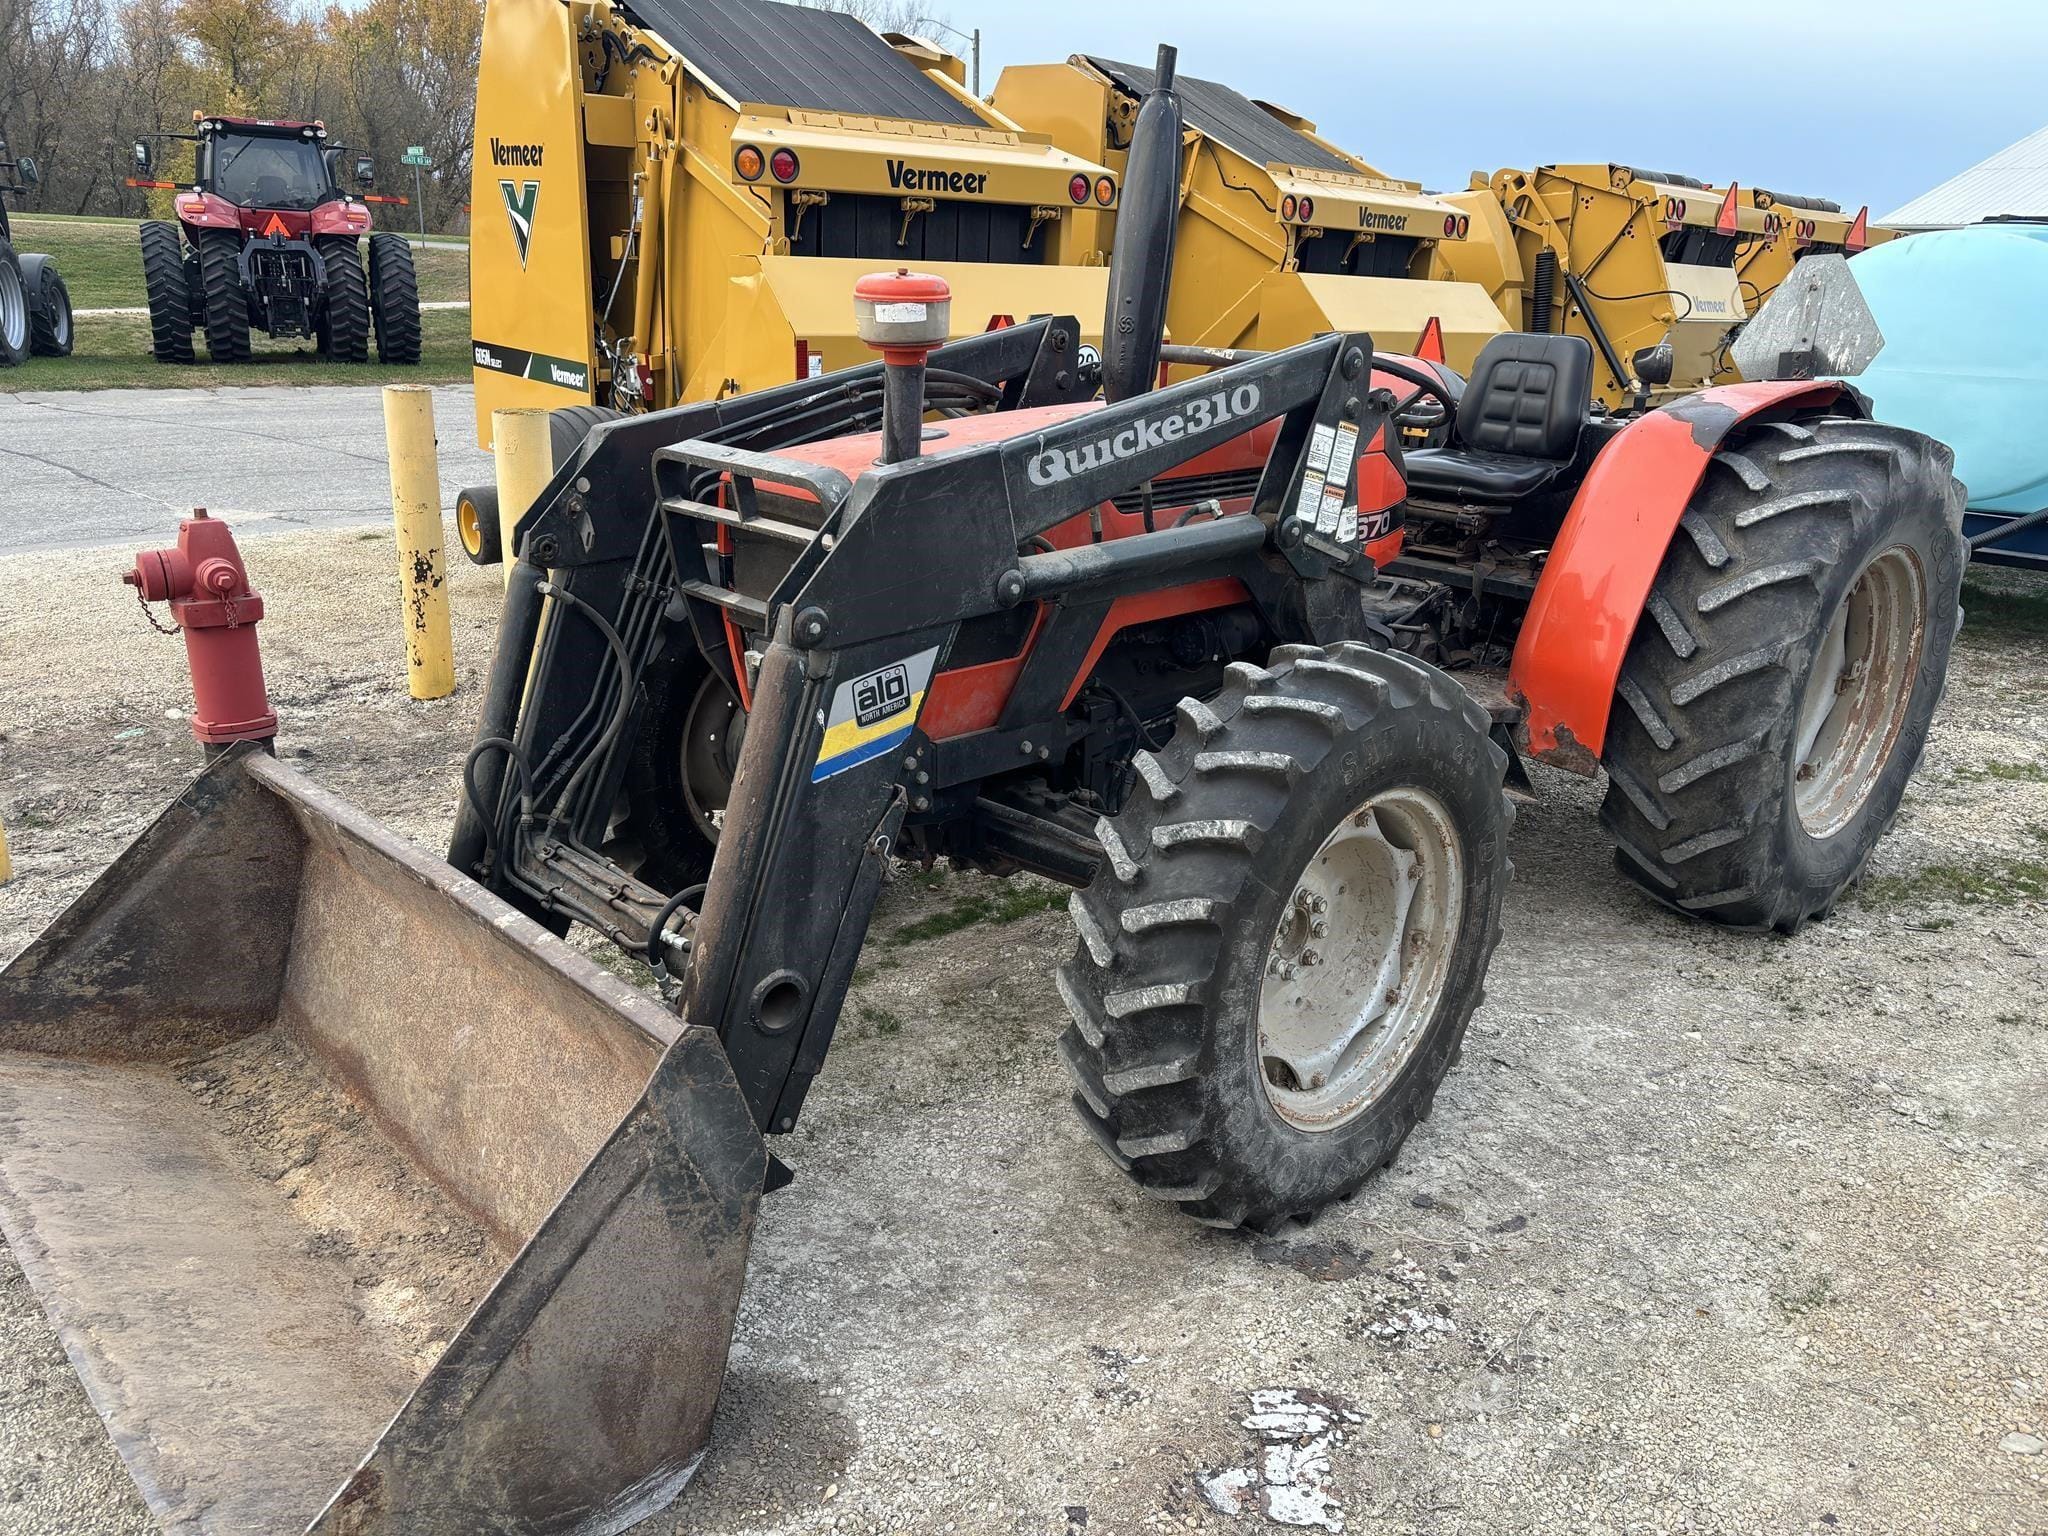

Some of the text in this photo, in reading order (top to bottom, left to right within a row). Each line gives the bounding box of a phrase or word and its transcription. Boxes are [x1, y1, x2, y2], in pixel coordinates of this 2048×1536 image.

[490, 137, 543, 167] Vermeer
[886, 159, 987, 194] Vermeer
[1358, 205, 1408, 231] Vermeer
[1692, 295, 1726, 313] Vermeer
[550, 363, 585, 388] Vermeer
[1328, 489, 1344, 498] WARNING
[861, 701, 907, 723] NORTH AMERICA
